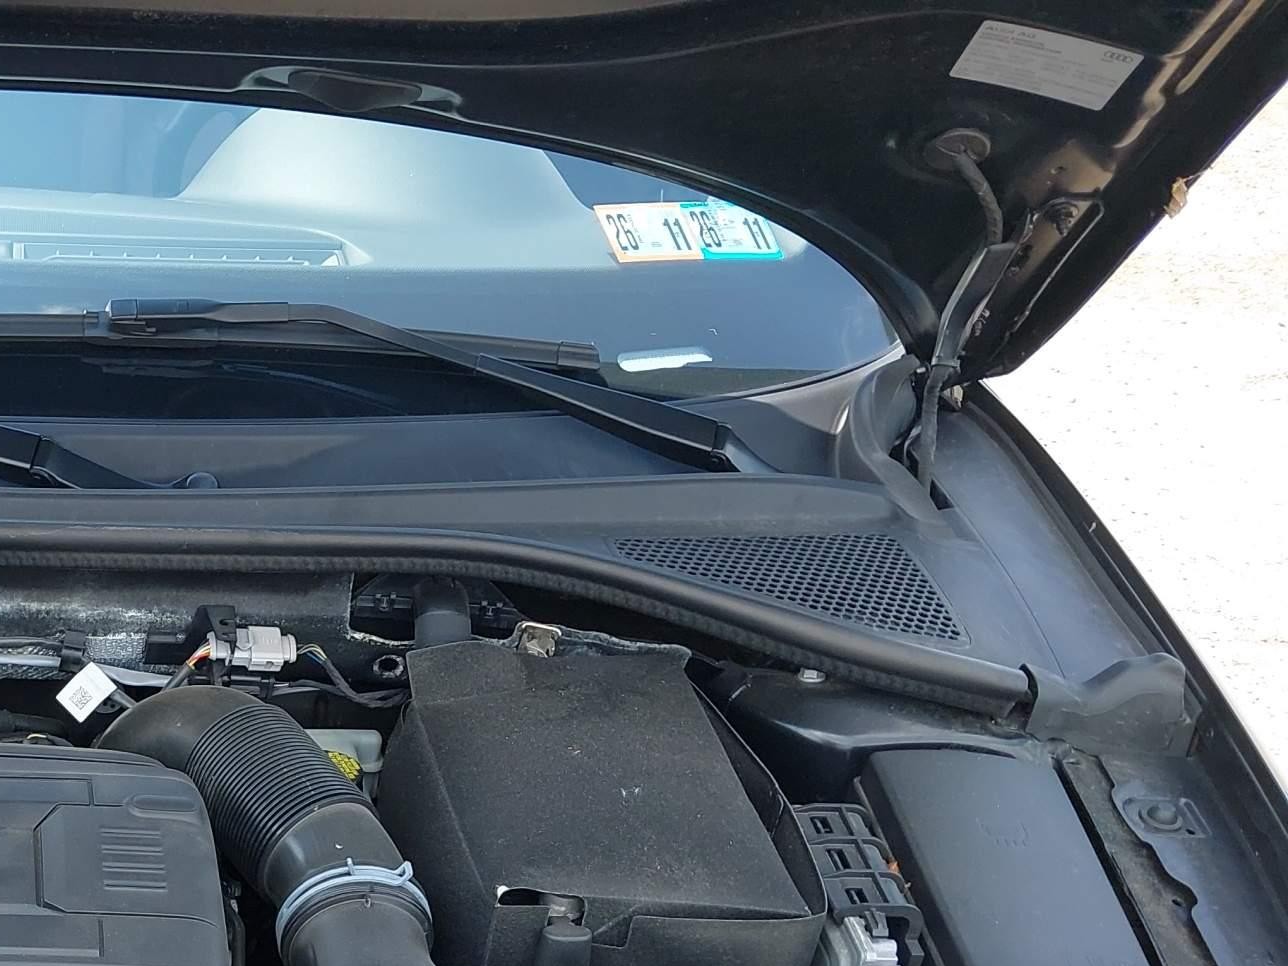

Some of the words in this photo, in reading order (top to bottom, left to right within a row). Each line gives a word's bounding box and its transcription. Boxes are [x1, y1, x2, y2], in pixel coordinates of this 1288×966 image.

[605, 213, 640, 251] 26
[662, 217, 692, 251] 11
[689, 210, 723, 249] 26
[742, 216, 772, 250] 11
